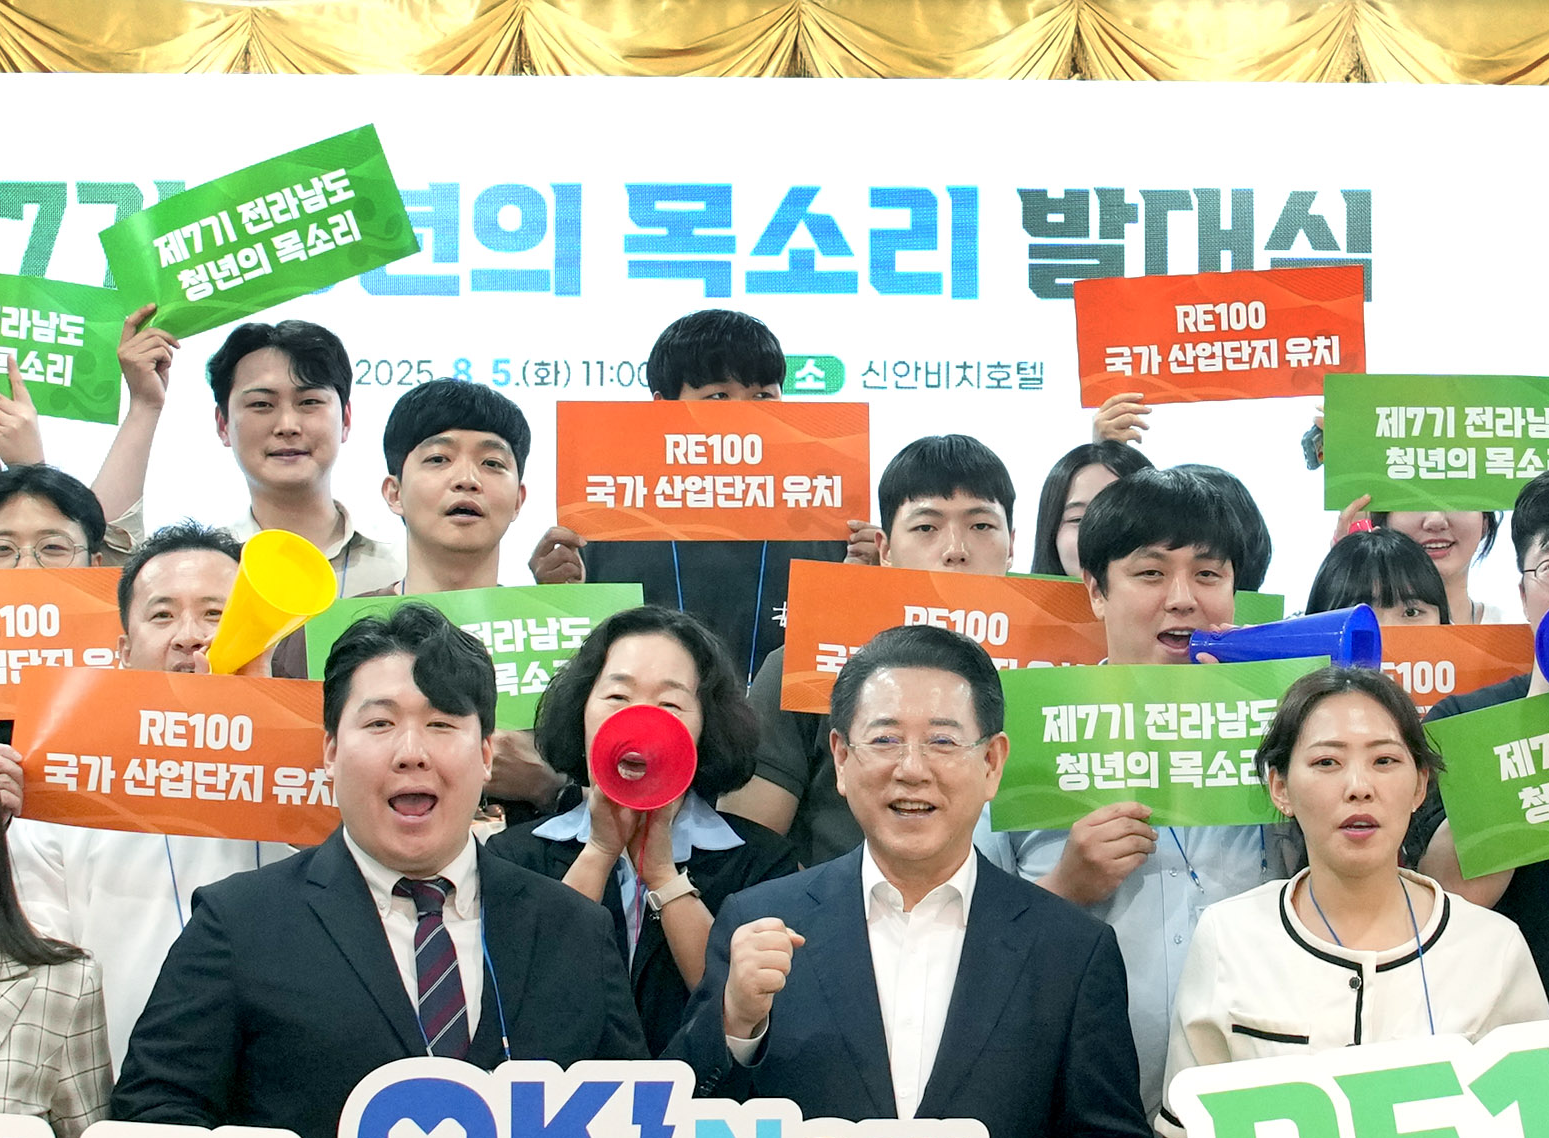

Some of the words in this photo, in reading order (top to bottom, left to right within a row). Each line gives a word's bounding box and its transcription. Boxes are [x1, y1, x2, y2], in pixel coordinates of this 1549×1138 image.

[153, 213, 235, 269] 제7기
[236, 167, 356, 232] 전라남도
[178, 246, 271, 303] 청년의
[274, 209, 363, 265] 목소리
[314, 182, 582, 297] 년의
[625, 182, 980, 300] 목소리
[1016, 187, 1372, 303] 발대식
[1175, 299, 1266, 335] RE100
[1104, 344, 1162, 377] 국가
[1166, 338, 1280, 375] 산업단지
[1283, 333, 1341, 370] 유치
[861, 359, 1045, 391] 신안비치호텔
[1375, 405, 1455, 440] 제7기
[664, 432, 763, 466] RE100
[1384, 445, 1477, 481] 청년의
[585, 474, 649, 510] 국가
[653, 474, 776, 510] 산업단지
[781, 474, 844, 510] 유치
[495, 660, 570, 697] 목소
[1381, 660, 1456, 695] 100
[138, 709, 254, 753] RE100
[1041, 703, 1135, 744] 제7기
[1144, 698, 1281, 742] 전라남도
[43, 751, 117, 794] 국가
[123, 757, 264, 804] 산업단지
[1055, 751, 1159, 792] 청년의
